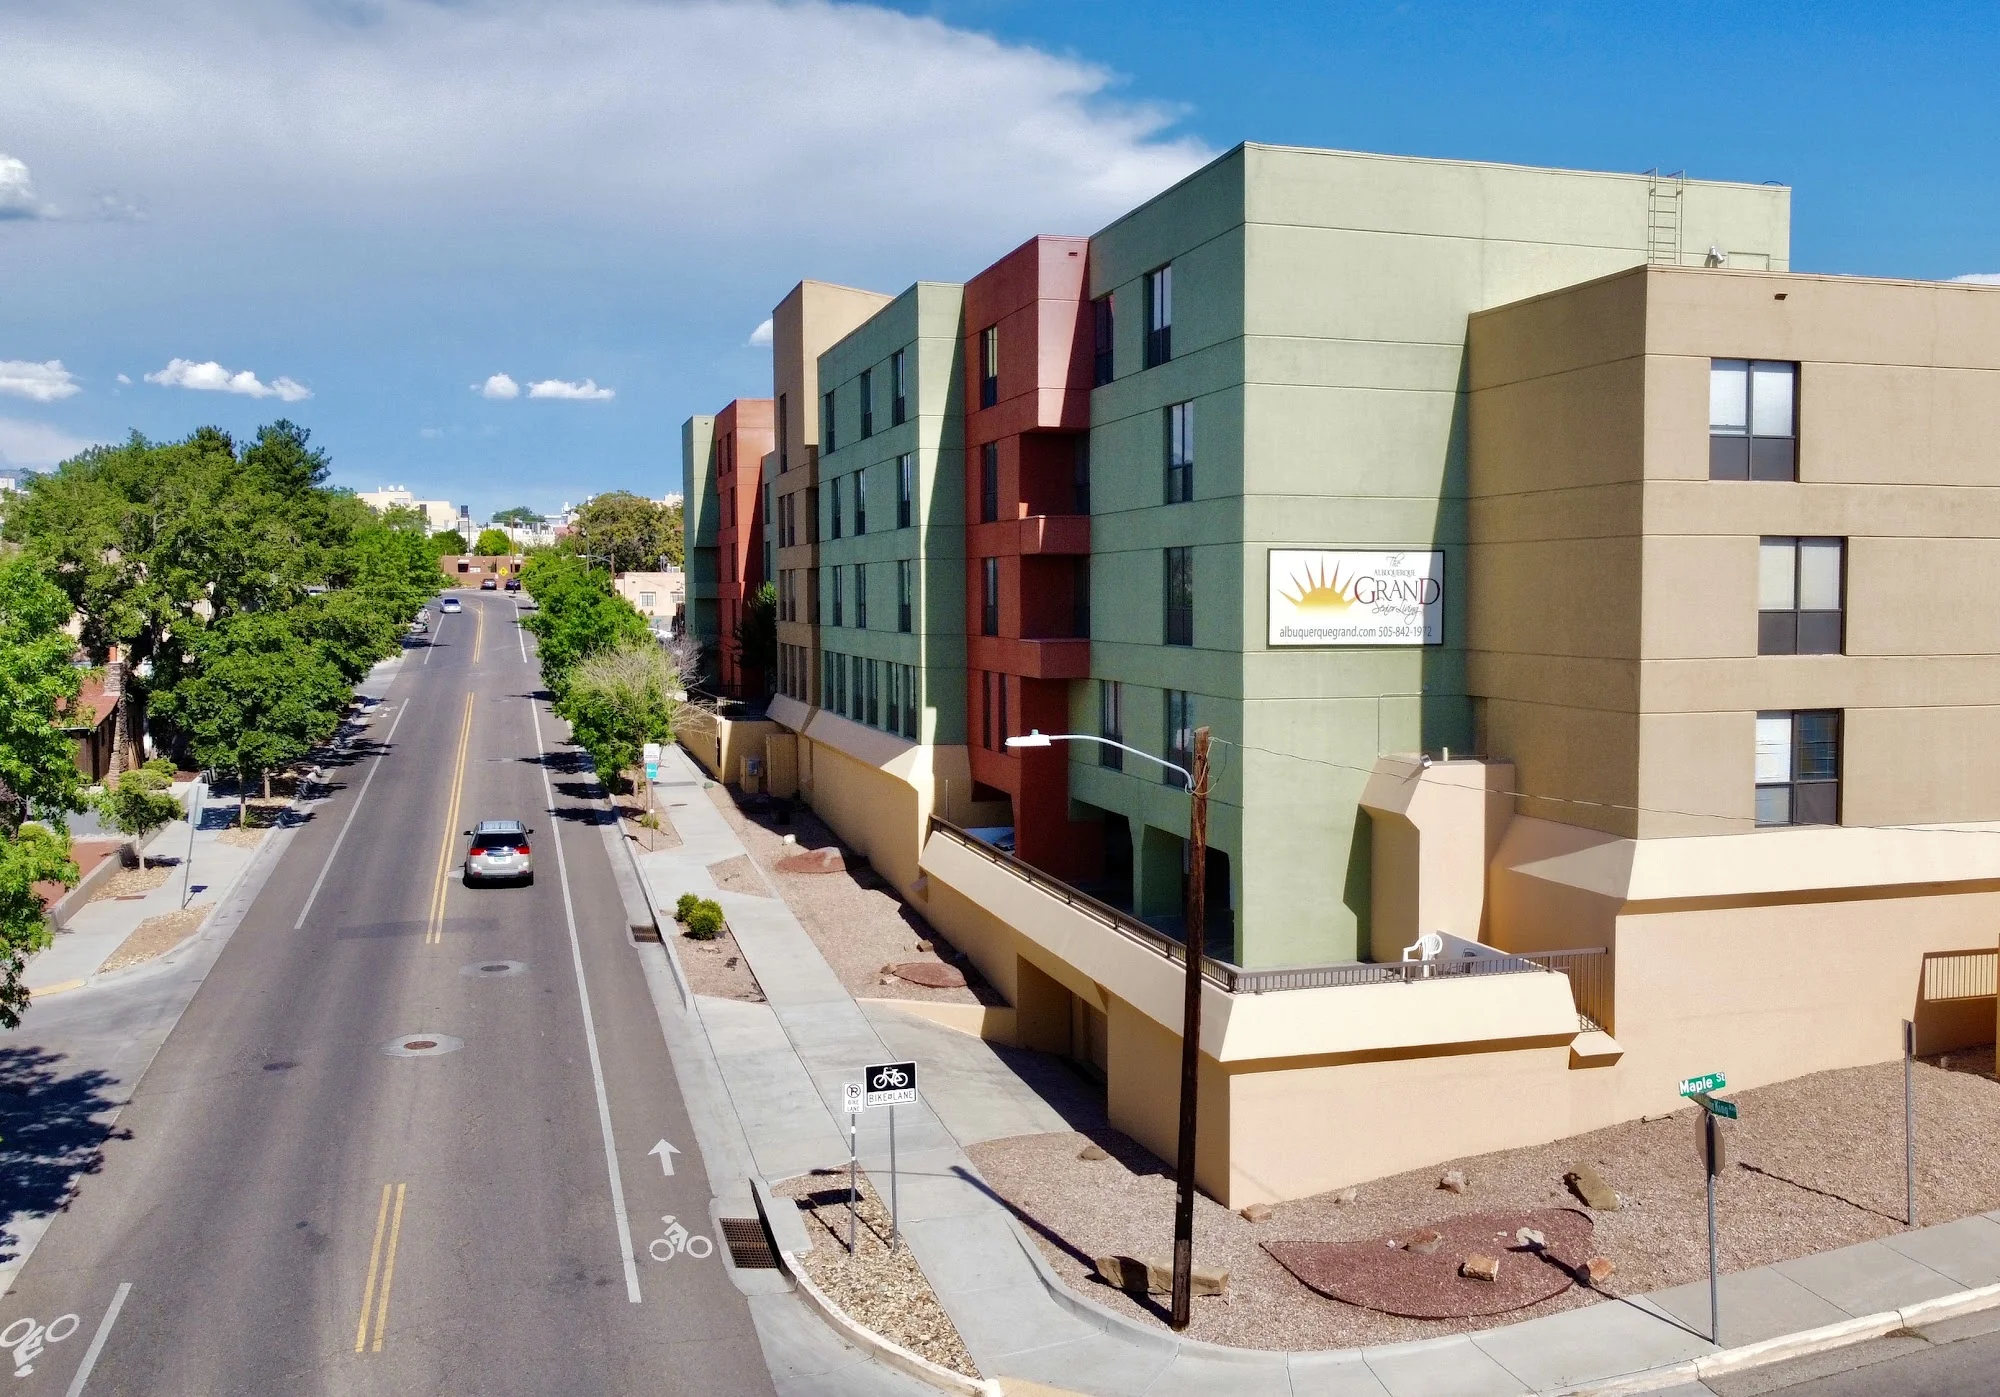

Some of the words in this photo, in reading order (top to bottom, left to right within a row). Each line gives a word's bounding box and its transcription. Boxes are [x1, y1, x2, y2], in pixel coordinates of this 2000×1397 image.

[1374, 569, 1416, 577] ALBUQUERQUE
[1354, 576, 1440, 605] GRAND
[1372, 598, 1396, 616] Senior
[1396, 600, 1421, 625] Living
[1280, 626, 1376, 640] albuquerquegrand.com
[1378, 626, 1432, 638] 505-842-1972
[1679, 1077, 1713, 1095] Maple
[1716, 1072, 1725, 1082] St
[869, 1093, 888, 1103] BIKE
[893, 1090, 913, 1101] LANE
